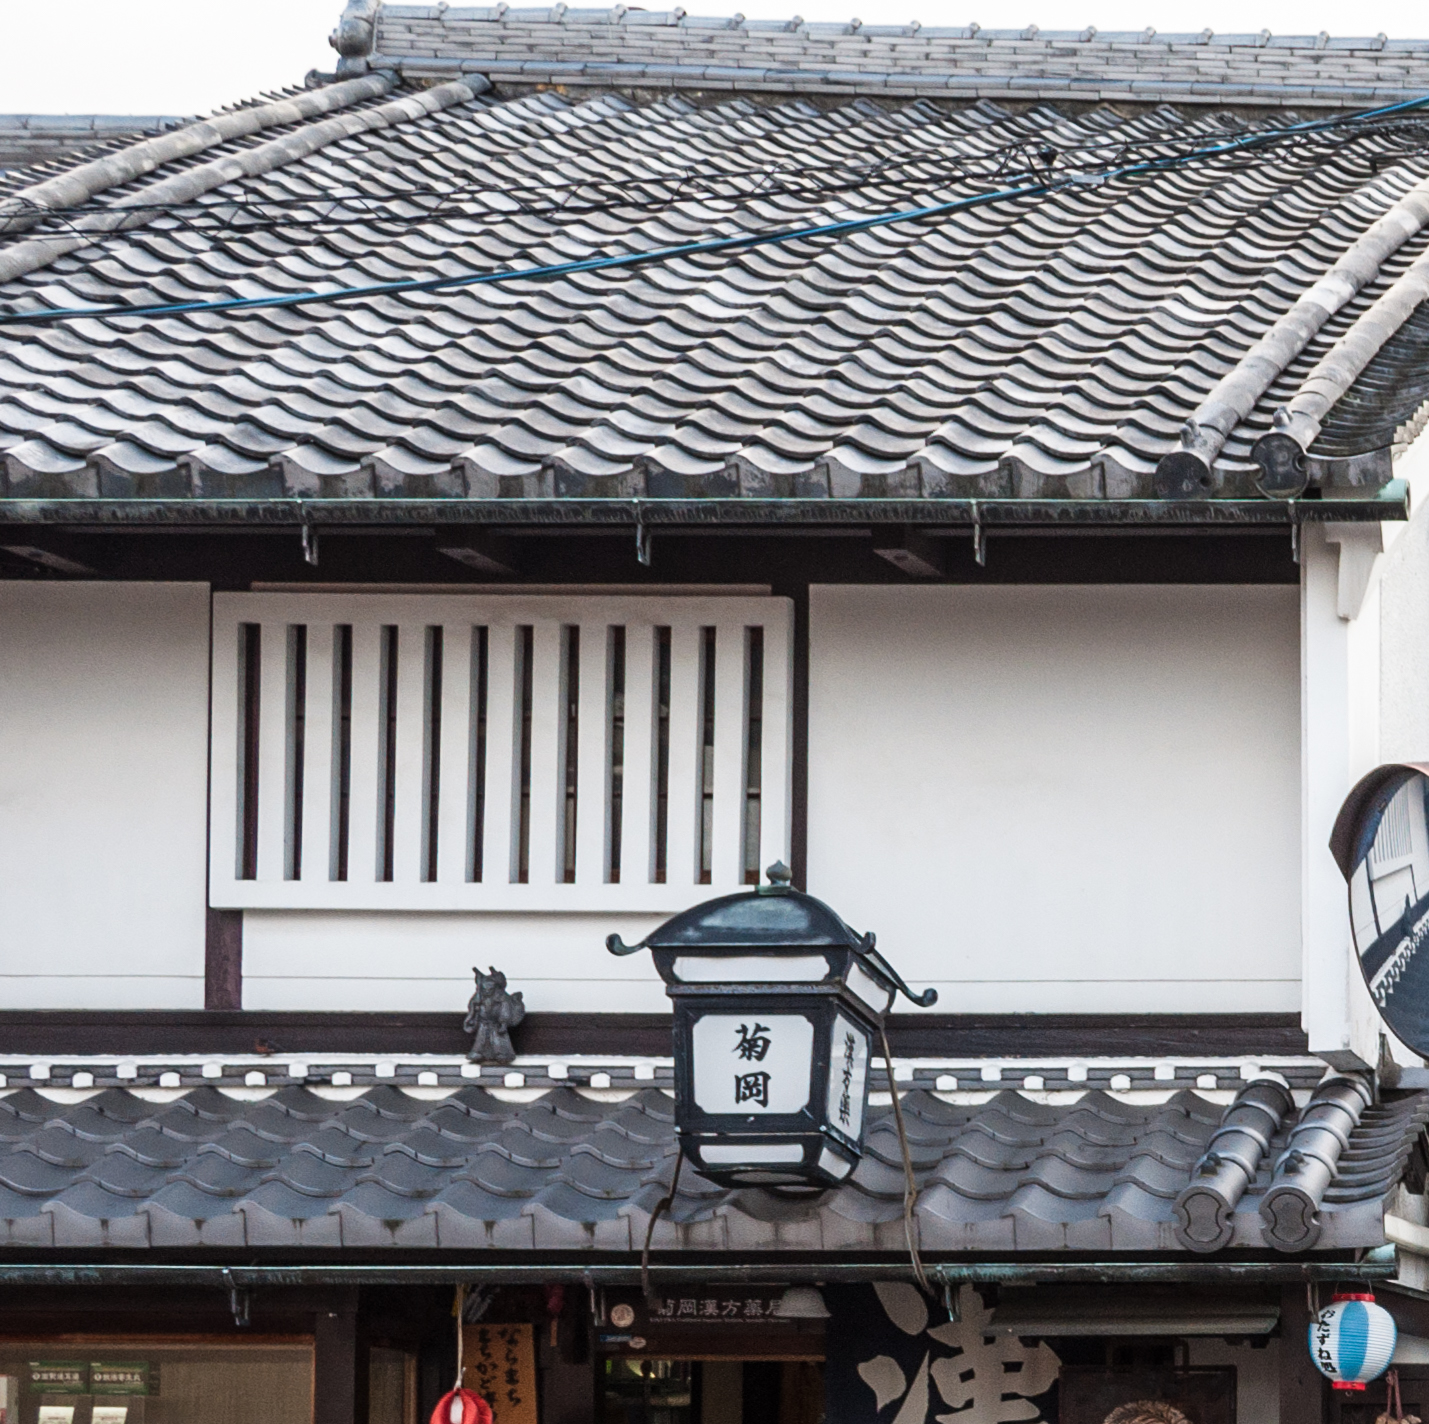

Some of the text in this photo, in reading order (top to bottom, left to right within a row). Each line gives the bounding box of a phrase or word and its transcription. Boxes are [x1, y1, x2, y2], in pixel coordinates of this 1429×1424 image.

[731, 1022, 772, 1108] 菊岡
[497, 1328, 522, 1407] ならまち
[1317, 1308, 1337, 1374] おたずね処
